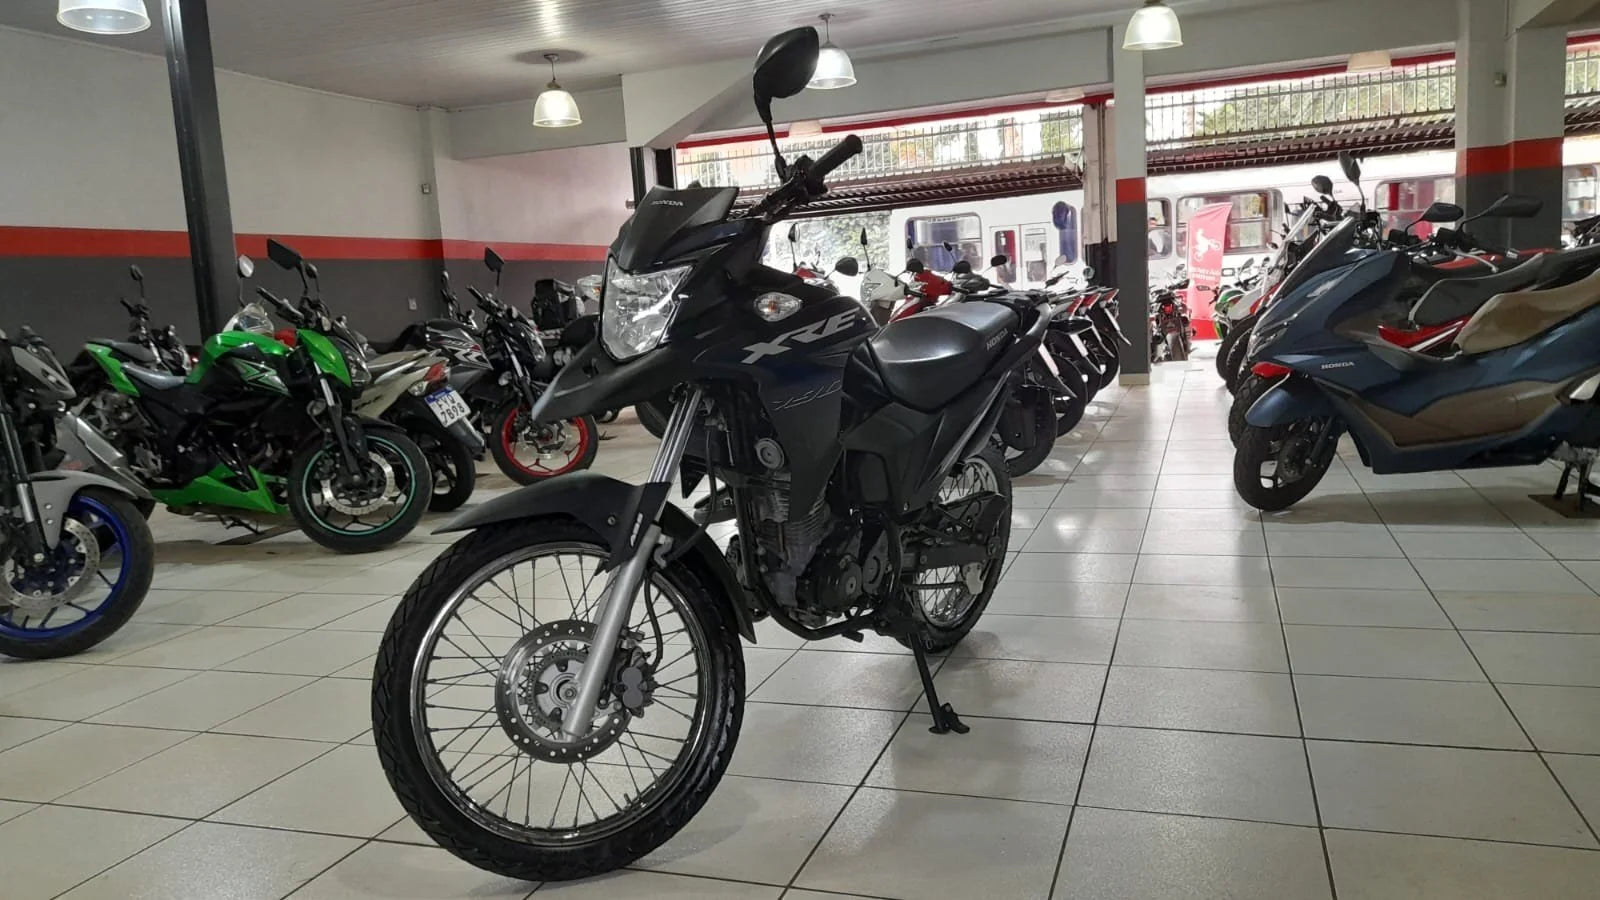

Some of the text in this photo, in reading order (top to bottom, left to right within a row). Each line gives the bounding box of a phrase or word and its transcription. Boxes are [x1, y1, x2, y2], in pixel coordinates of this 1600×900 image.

[740, 306, 861, 364] XRE
[986, 327, 1009, 351] HONDA
[1321, 361, 1356, 370] HONDA
